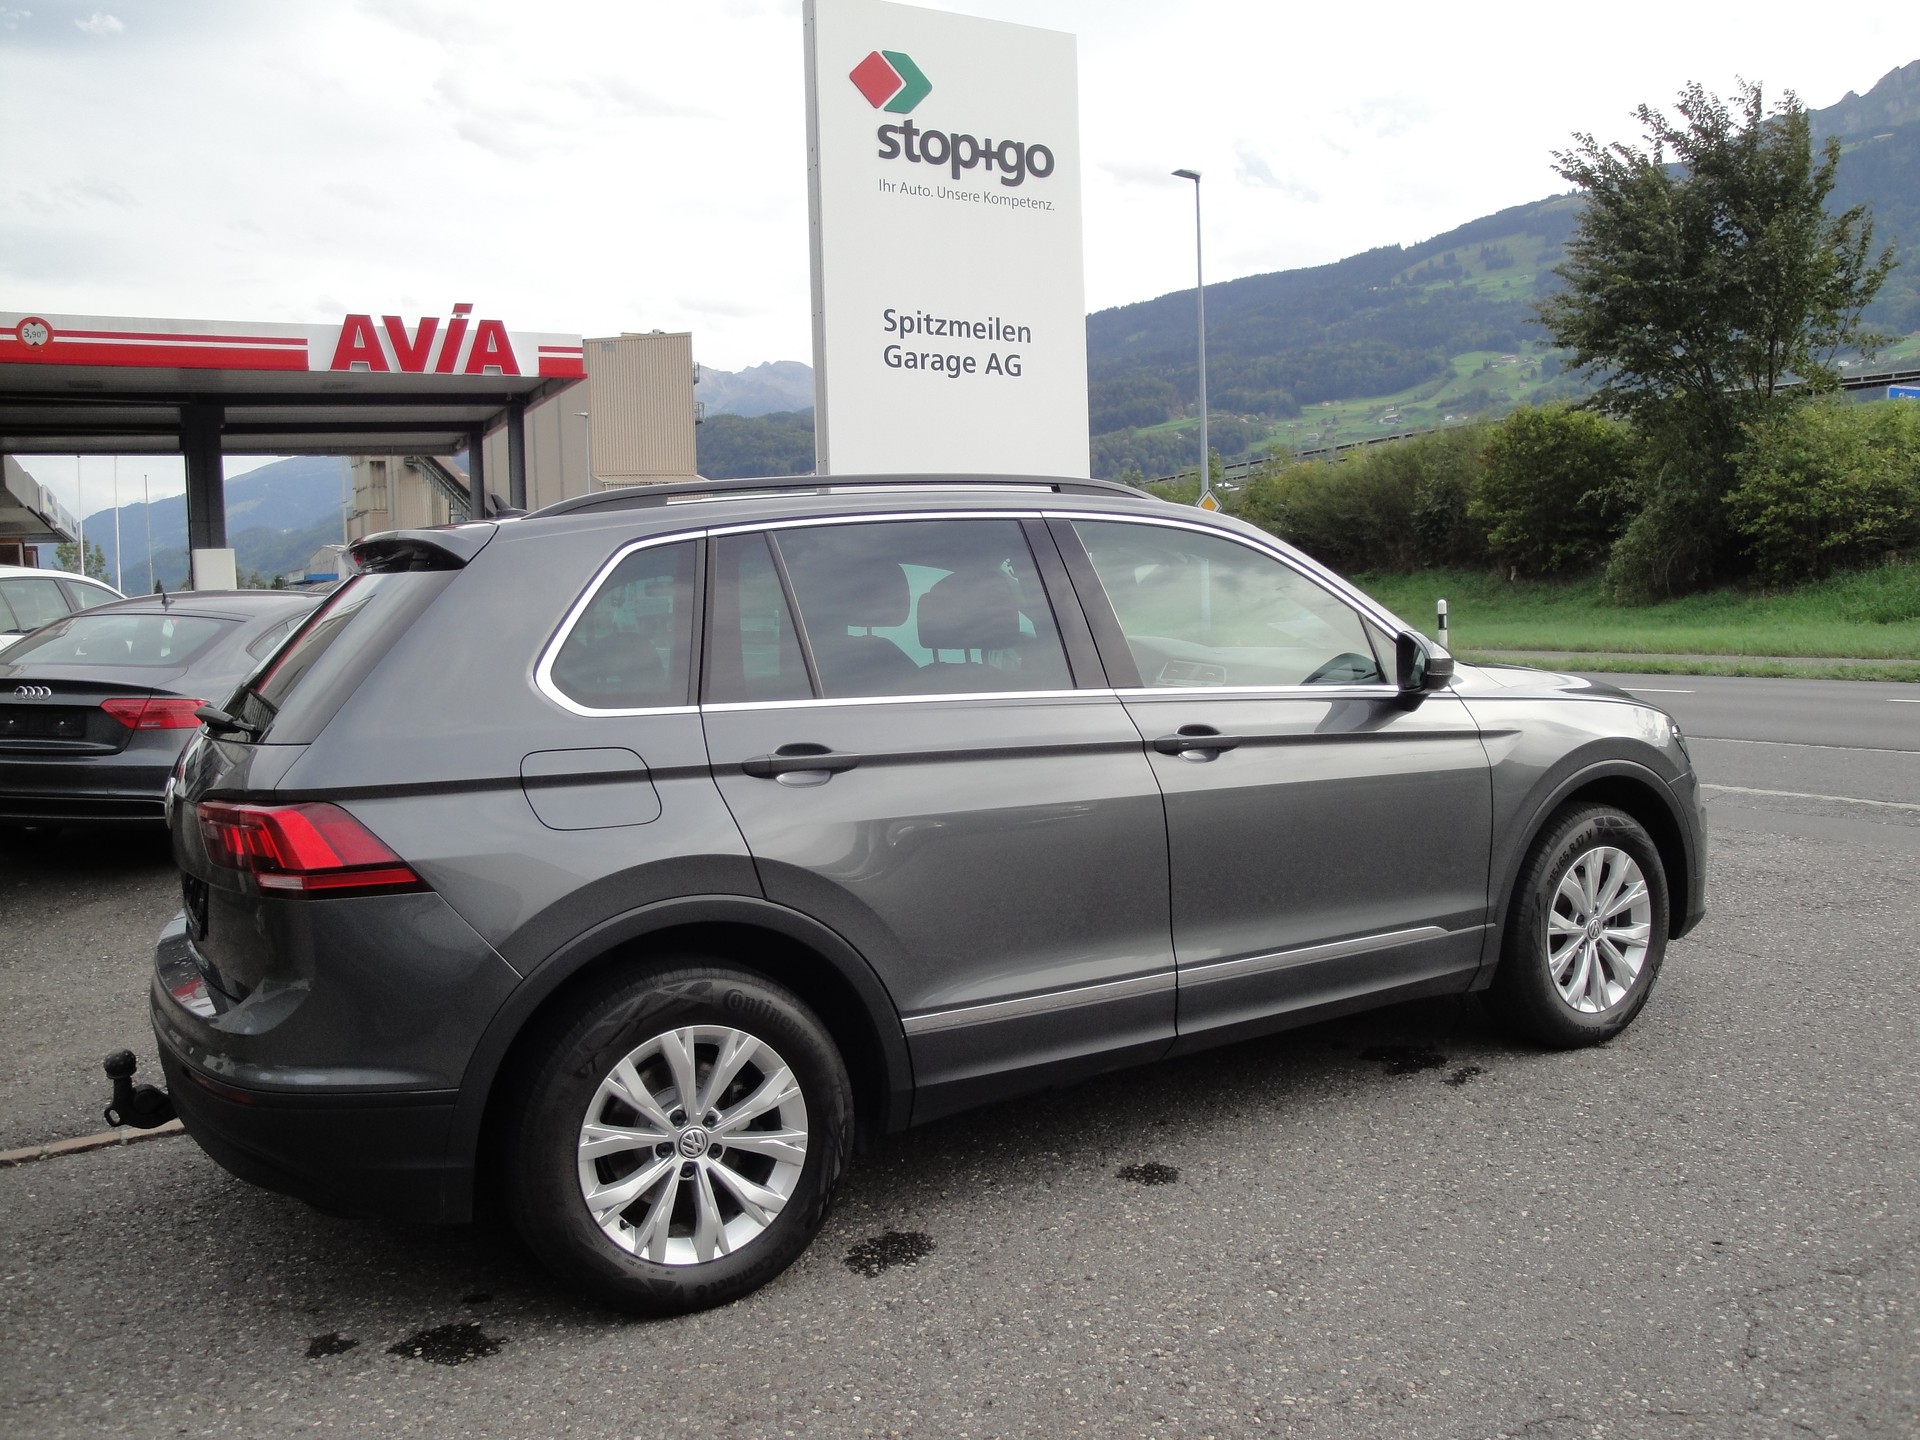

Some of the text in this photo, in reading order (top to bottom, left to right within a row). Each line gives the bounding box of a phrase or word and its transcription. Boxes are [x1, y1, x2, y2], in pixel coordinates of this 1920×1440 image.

[877, 119, 1055, 187] stop+go
[878, 178, 1055, 211] Ihr Auto. Unsere Kompetenz.
[883, 308, 1032, 343] Spitzmeilen
[883, 344, 1022, 379] Garage AG
